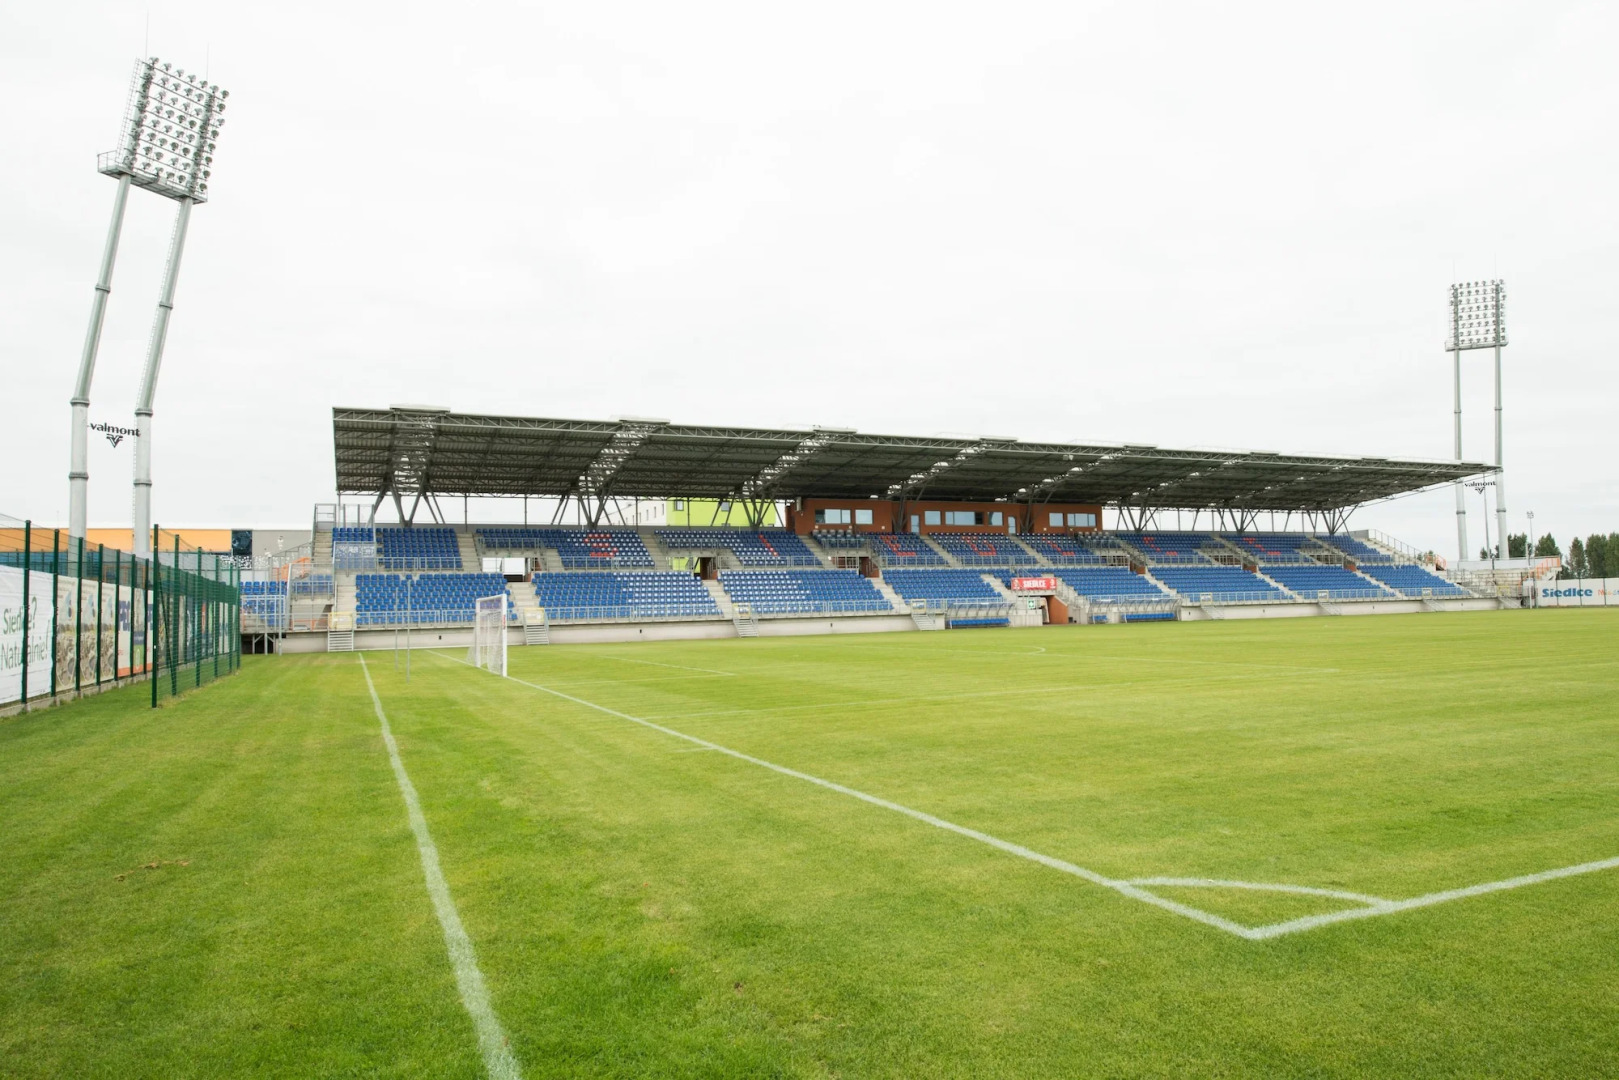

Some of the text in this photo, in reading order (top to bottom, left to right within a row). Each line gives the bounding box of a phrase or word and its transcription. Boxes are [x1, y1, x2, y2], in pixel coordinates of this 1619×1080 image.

[90, 422, 141, 437] valmont
[1541, 588, 1593, 598] Siedlce
[0, 619, 50, 671] Natualnie!
